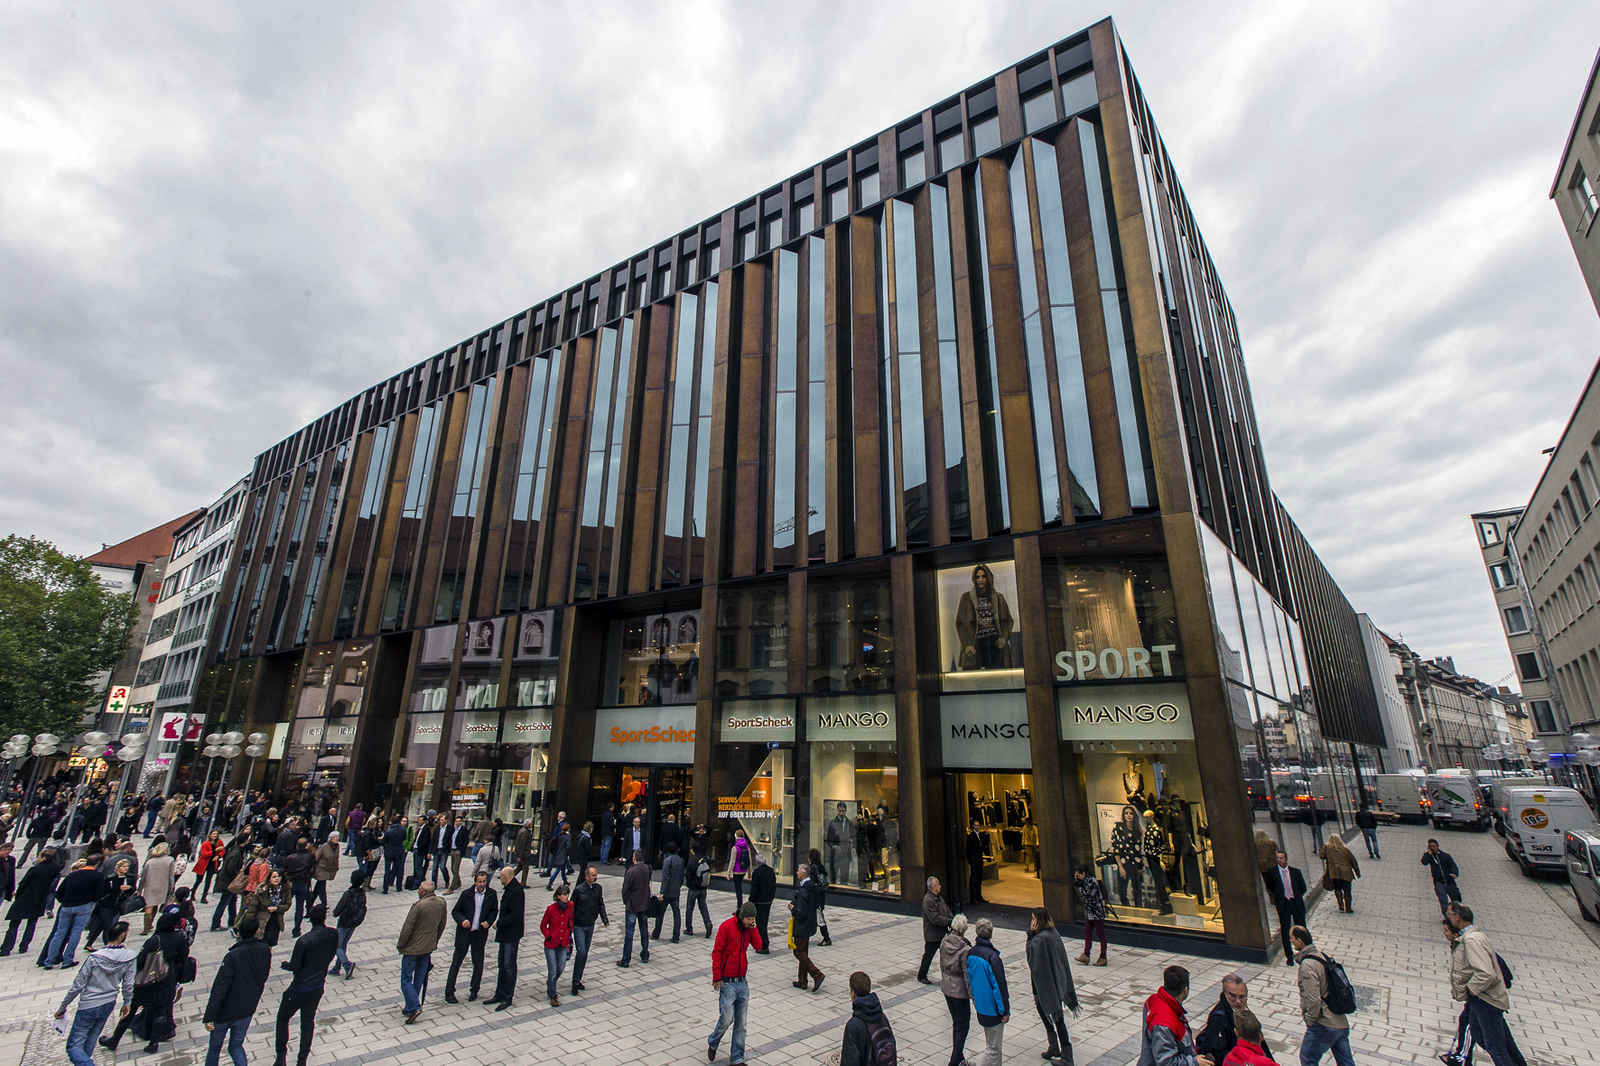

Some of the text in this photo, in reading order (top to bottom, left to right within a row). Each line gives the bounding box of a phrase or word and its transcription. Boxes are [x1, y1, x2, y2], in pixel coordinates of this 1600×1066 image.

[1055, 644, 1176, 681] SPORT
[818, 711, 891, 729] MANGO
[1072, 702, 1181, 725] MANGO
[728, 716, 794, 730] SportScheck
[950, 723, 1031, 740] MANGO
[718, 796, 738, 804] SERVUS
[717, 811, 730, 819] AUF
[745, 811, 766, 819] 10.000
